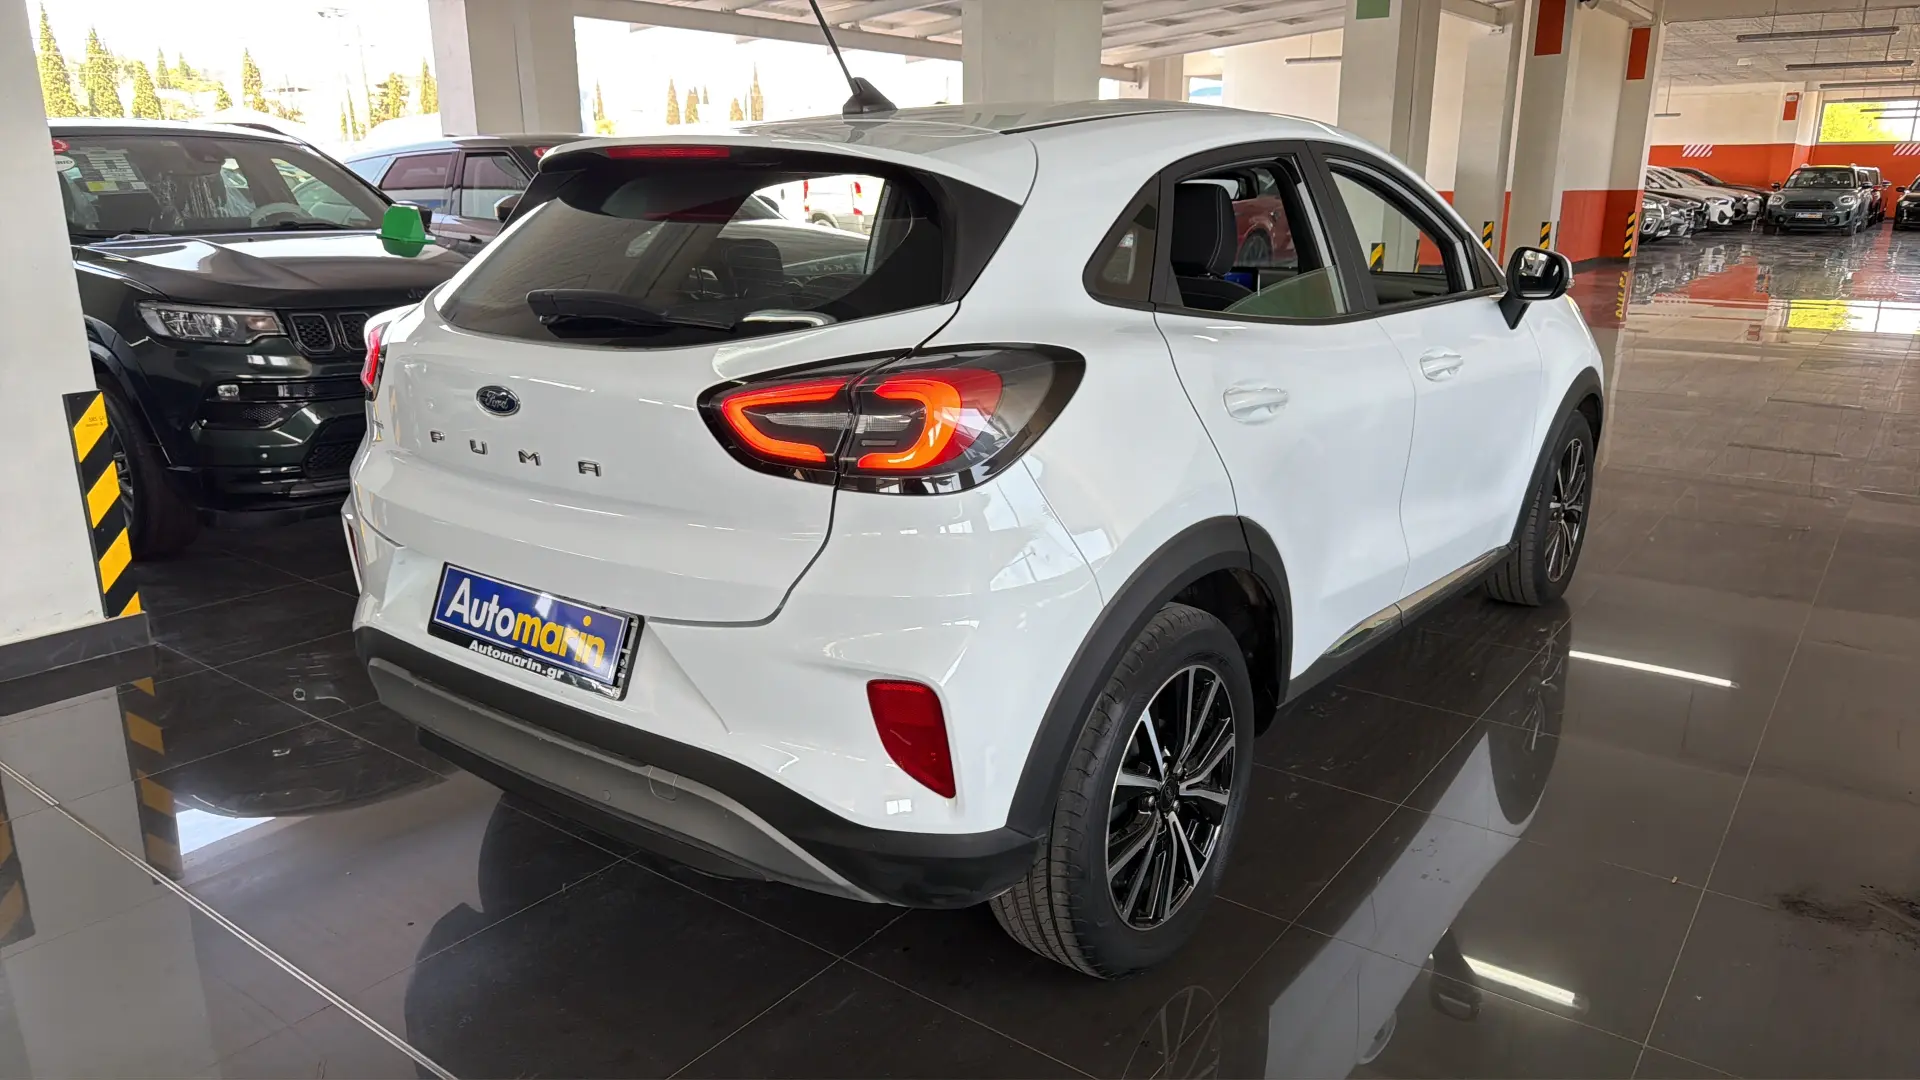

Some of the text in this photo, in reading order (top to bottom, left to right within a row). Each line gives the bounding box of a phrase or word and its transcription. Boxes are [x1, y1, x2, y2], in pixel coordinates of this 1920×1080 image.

[430, 430, 601, 477] PUMA
[444, 577, 605, 668] Automarin
[469, 640, 565, 680] Automarin.gr
